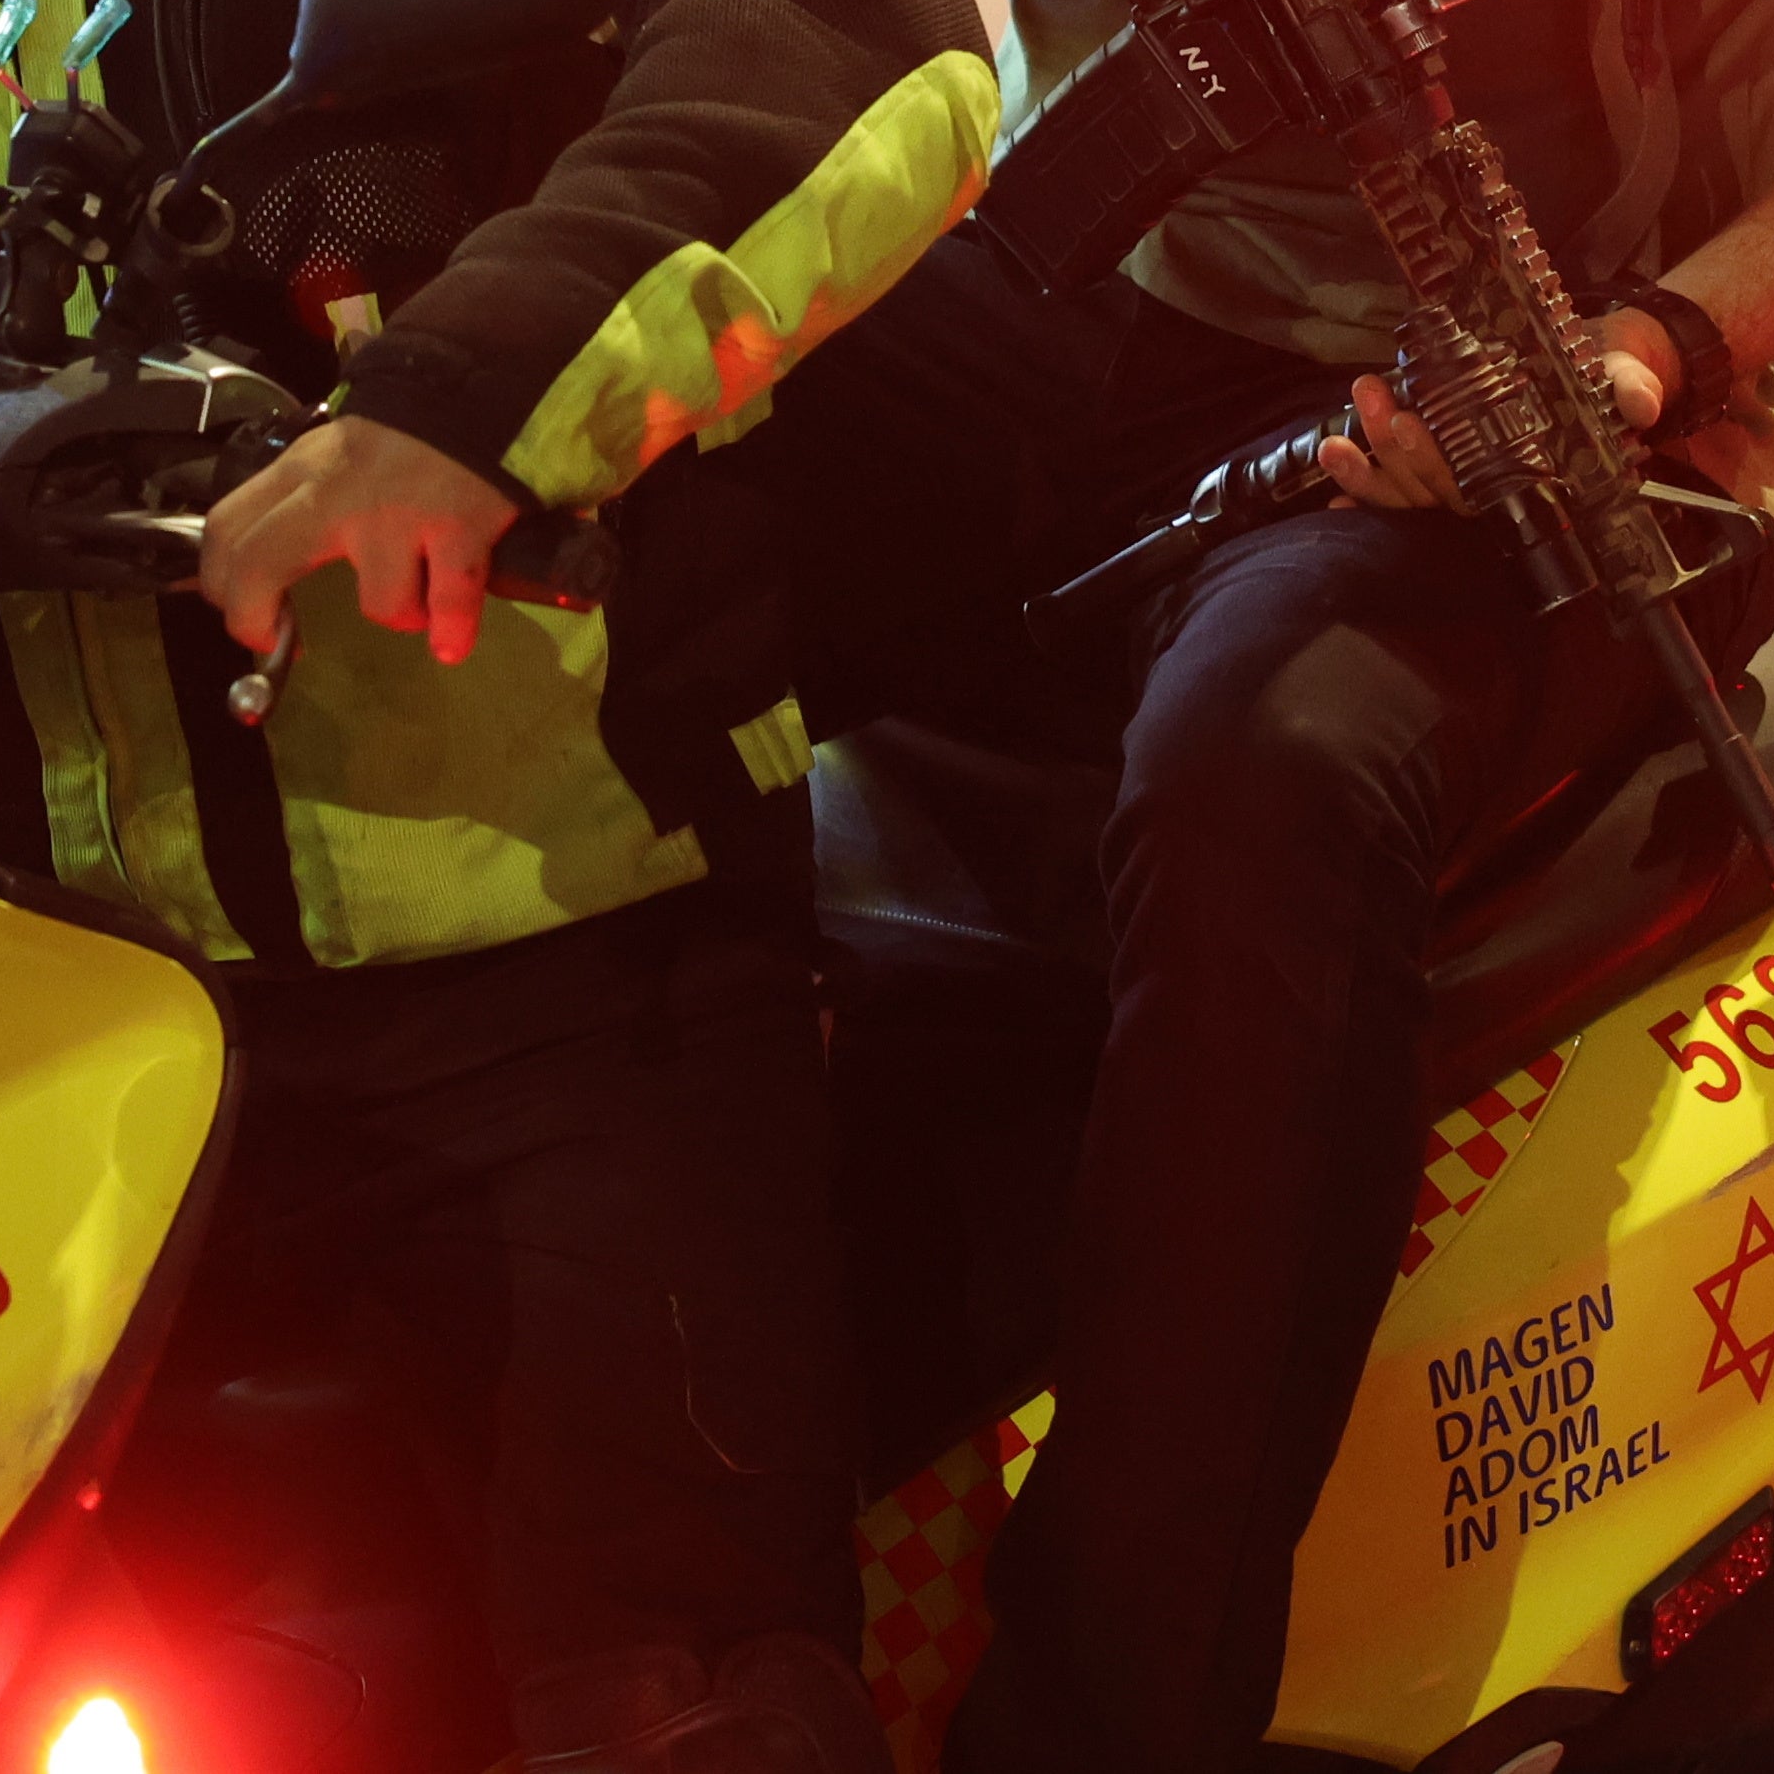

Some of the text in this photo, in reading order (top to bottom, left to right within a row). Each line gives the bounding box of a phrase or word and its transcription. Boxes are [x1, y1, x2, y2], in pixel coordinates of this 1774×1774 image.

[1428, 1282, 1615, 1410] MAGEN
[1435, 1356, 1595, 1463] DAVID
[1444, 1404, 1600, 1517] ADOM
[1445, 1420, 1671, 1569] IN ISRAEL
